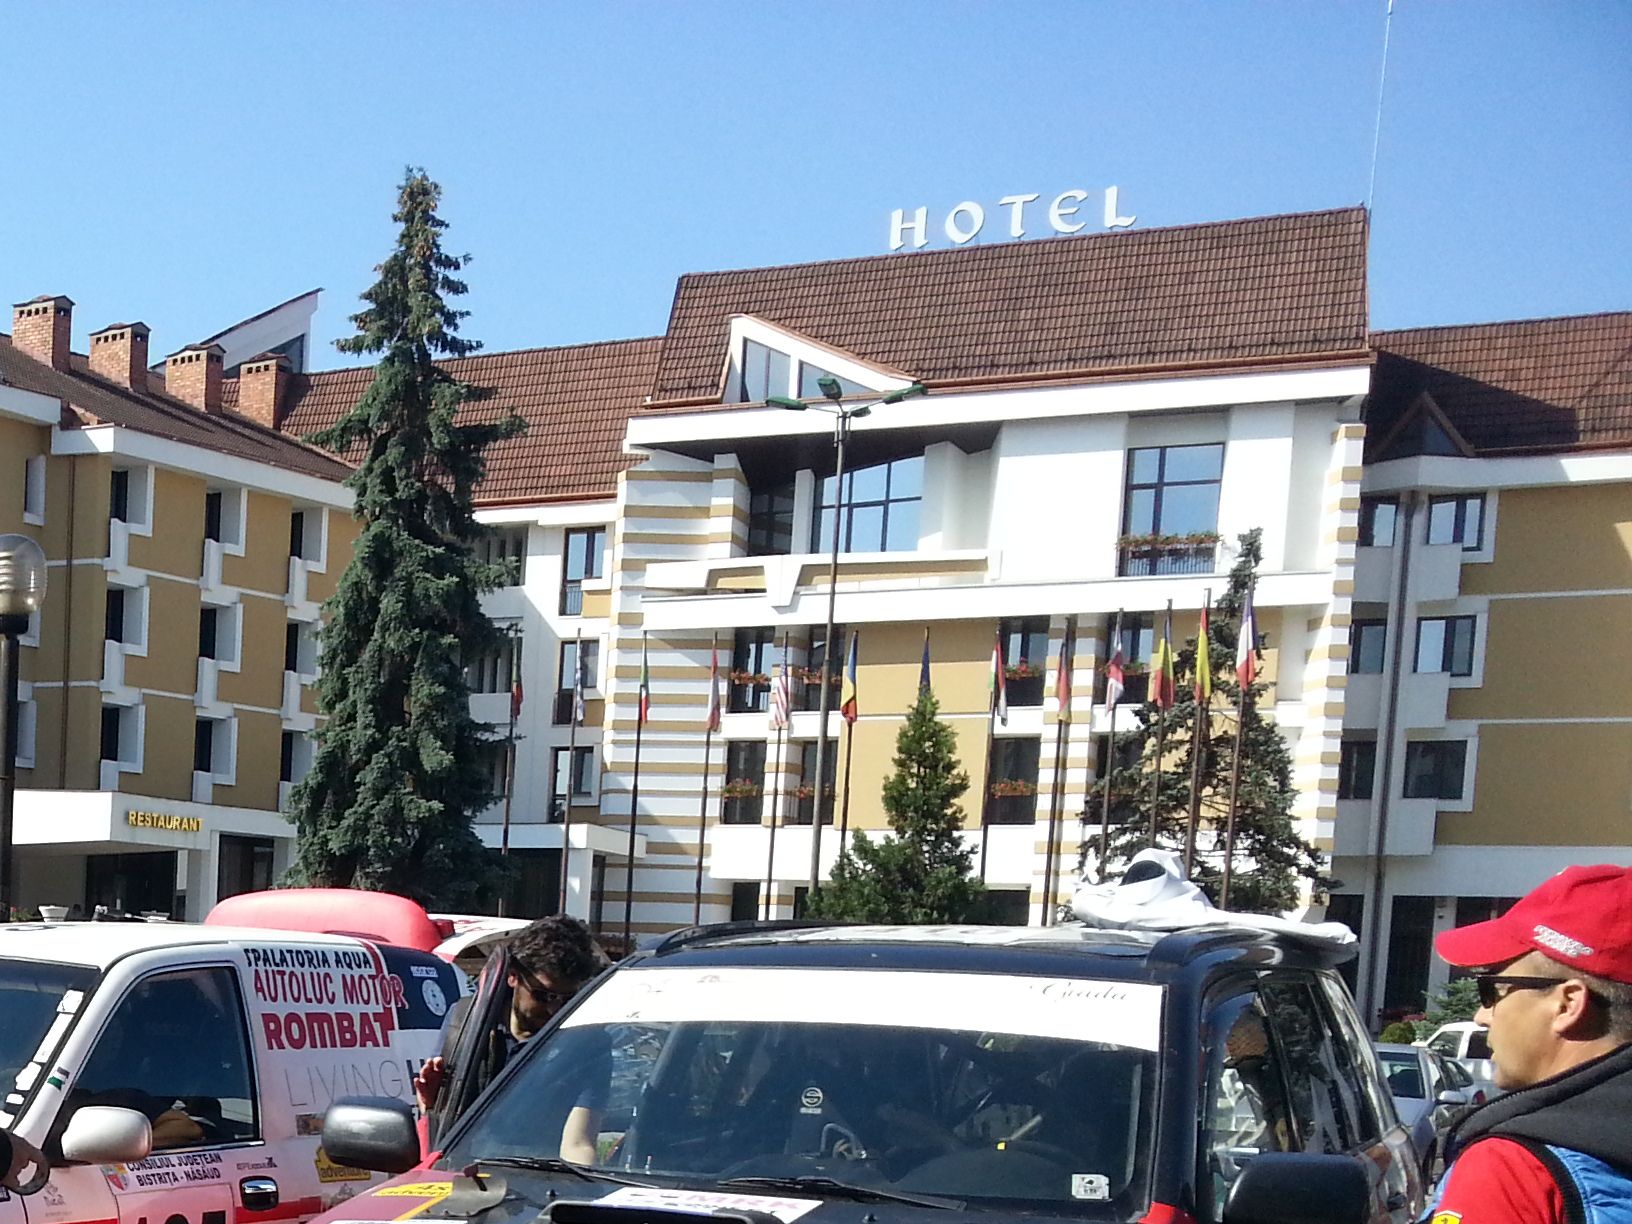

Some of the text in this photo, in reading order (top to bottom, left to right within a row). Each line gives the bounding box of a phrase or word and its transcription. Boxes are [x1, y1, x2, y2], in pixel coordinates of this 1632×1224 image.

[889, 185, 1137, 251] HOTEL
[128, 809, 204, 832] RESTAURANT
[244, 948, 373, 969] SPALATORIA AQUA
[254, 968, 409, 1009] AUTOLUC MOTOR
[261, 1012, 396, 1050] ROMBAT
[126, 1154, 174, 1172] CONSILIUL
